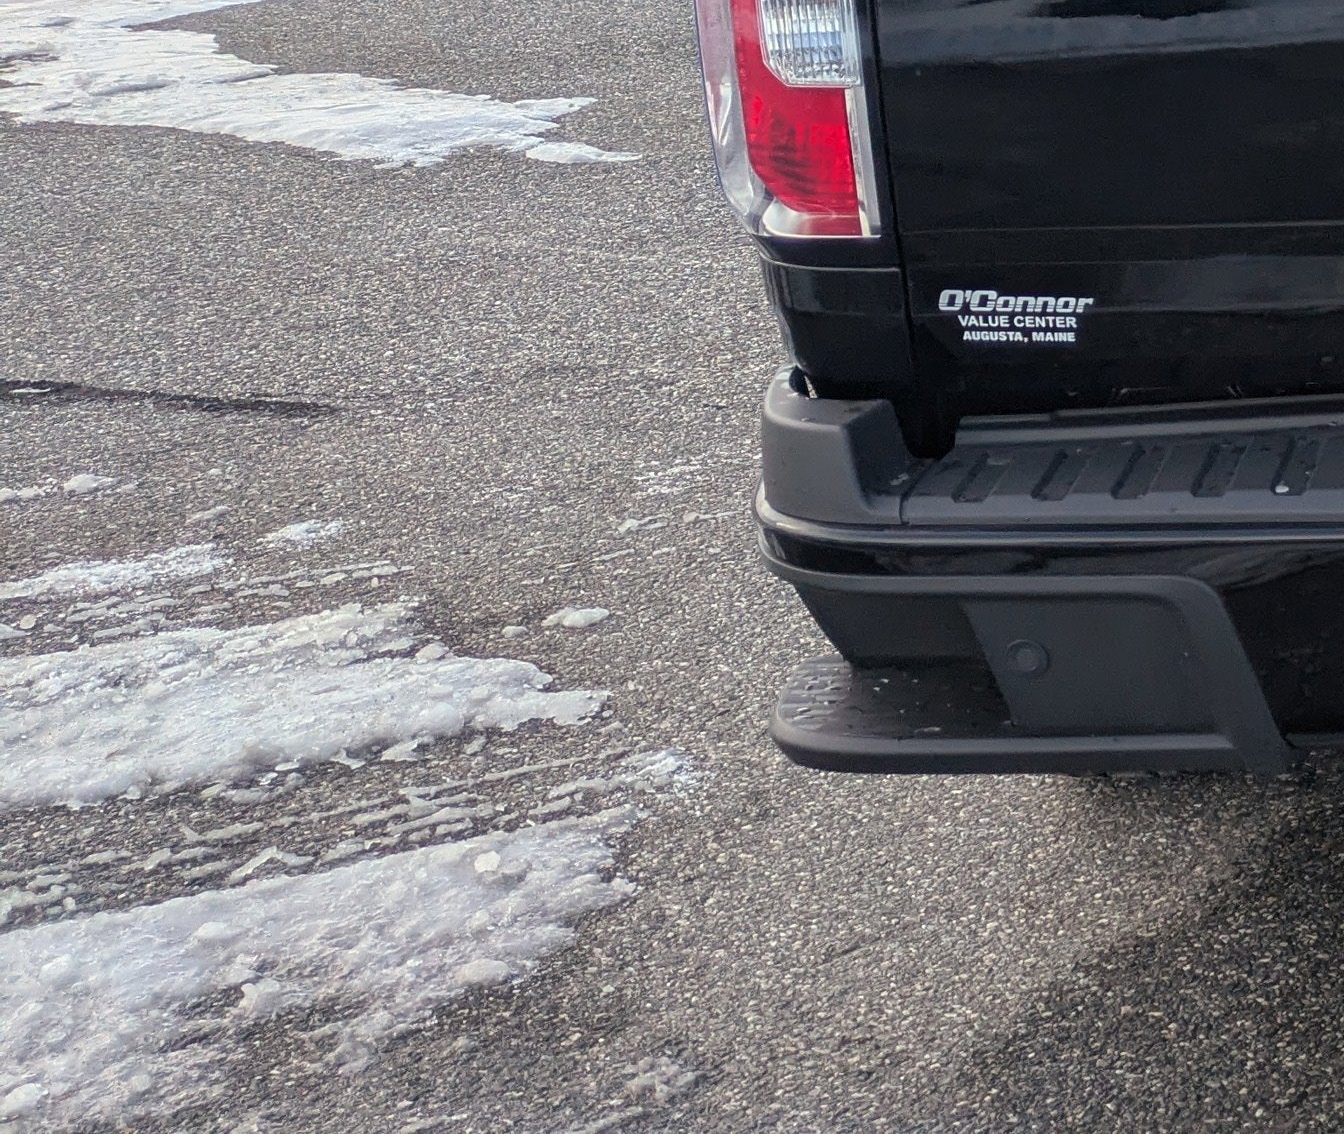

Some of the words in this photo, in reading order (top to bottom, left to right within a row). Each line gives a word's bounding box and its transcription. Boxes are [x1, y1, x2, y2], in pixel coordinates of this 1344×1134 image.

[938, 288, 1095, 314] O'Connor
[957, 315, 1010, 328] VALUE
[1013, 315, 1078, 329] CENTER
[962, 331, 1029, 343] AUGUSTA,
[1031, 331, 1076, 343] MAINE
